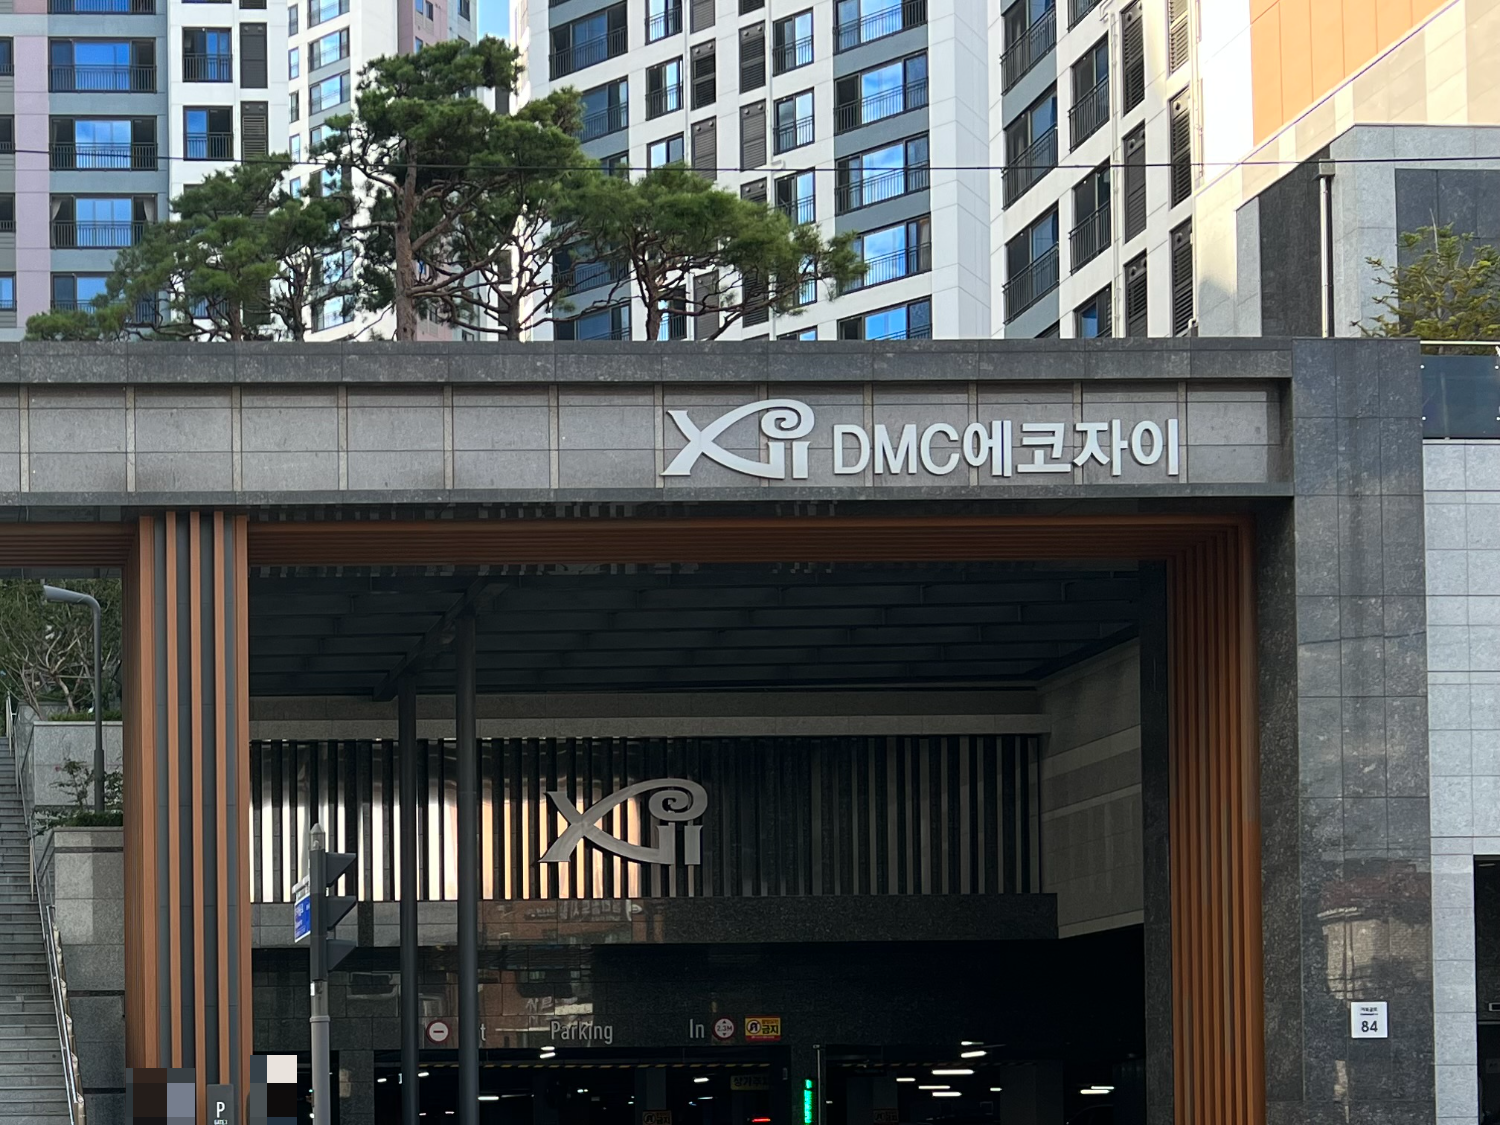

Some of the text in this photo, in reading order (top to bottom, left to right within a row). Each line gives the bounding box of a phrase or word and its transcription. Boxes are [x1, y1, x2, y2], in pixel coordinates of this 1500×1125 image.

[833, 419, 1179, 477] DMC에코자이
[551, 1019, 705, 1045] Parking In
[762, 1024, 779, 1034] 금지
[1361, 1021, 1378, 1032] 84
[216, 1101, 226, 1118] P
